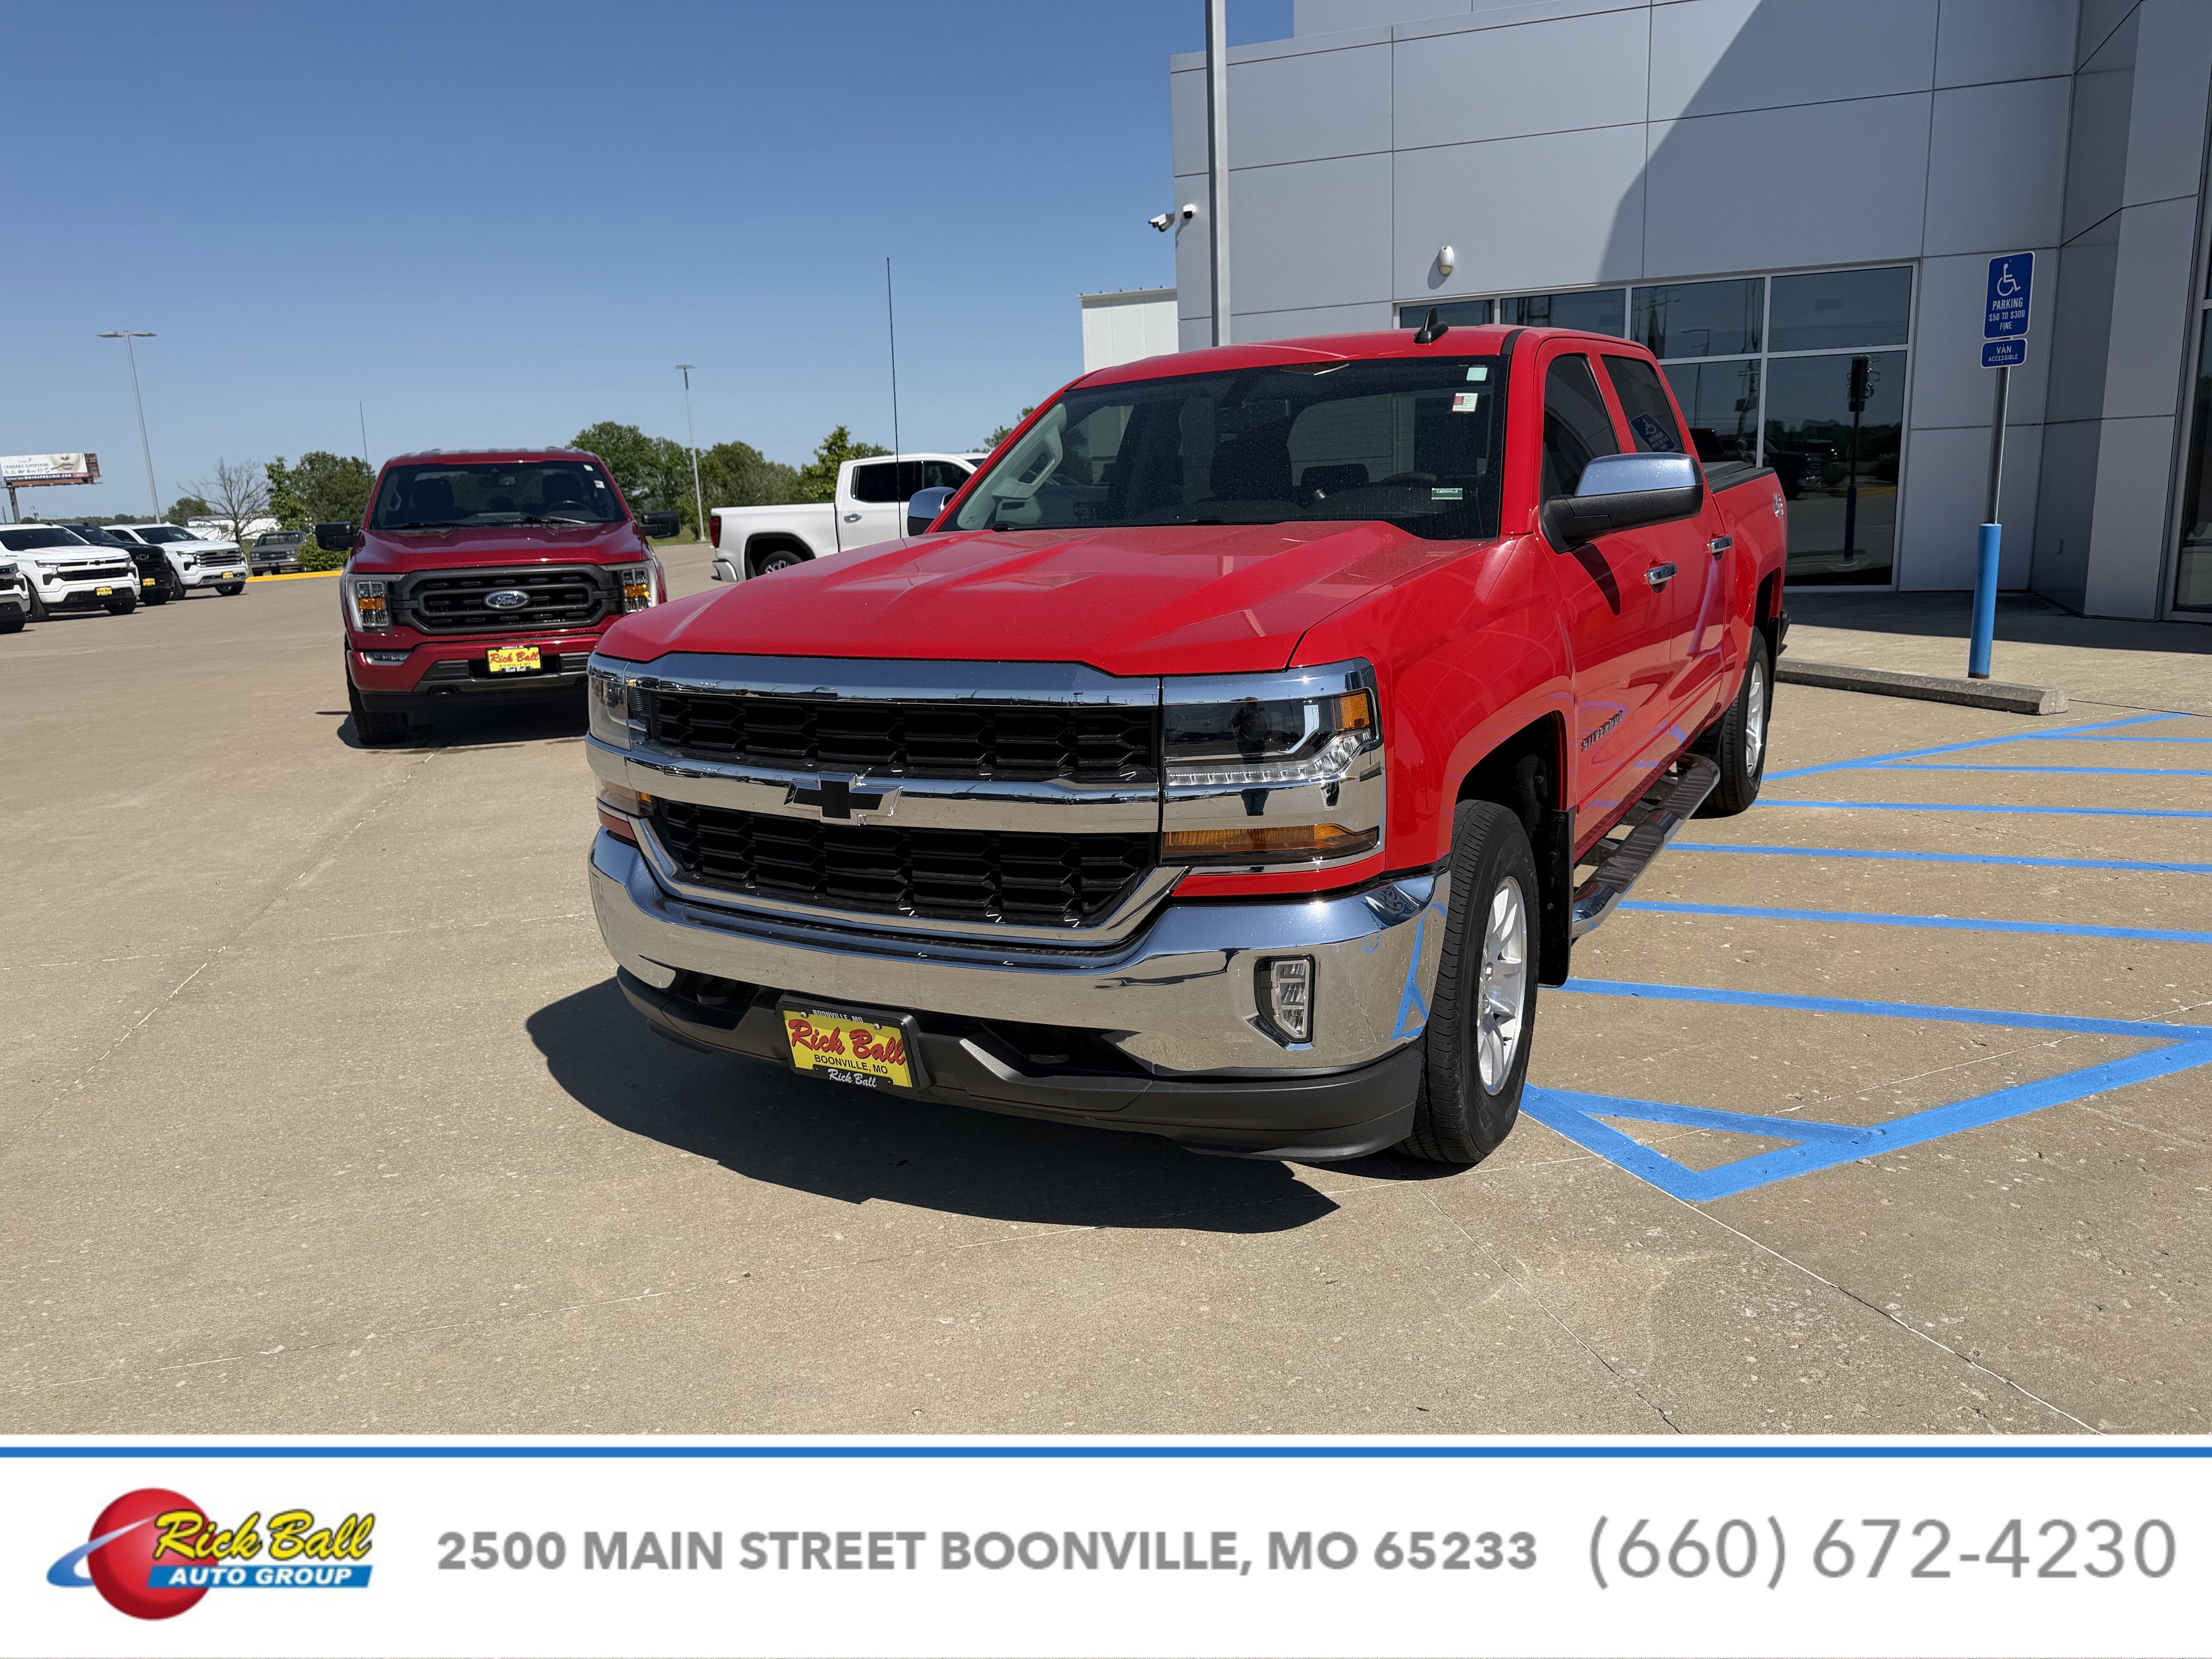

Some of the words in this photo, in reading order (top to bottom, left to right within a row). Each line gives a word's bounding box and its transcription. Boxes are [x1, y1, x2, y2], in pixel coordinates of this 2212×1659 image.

[1992, 297, 2023, 311] PARKING
[2002, 311, 2008, 320] TO
[2000, 321, 2012, 330] FINE
[1997, 345, 2011, 354] VAN
[496, 596, 518, 605] Ford
[490, 653, 513, 663] Rick
[516, 651, 539, 662] Ball
[812, 1009, 851, 1022] BOONVILLE,
[788, 1019, 845, 1054] Rick
[849, 1029, 906, 1065] Ball
[814, 1054, 871, 1072] BOONVILLE,
[873, 1063, 888, 1074] MO
[828, 1068, 852, 1084] Rick
[854, 1073, 877, 1087] Ball
